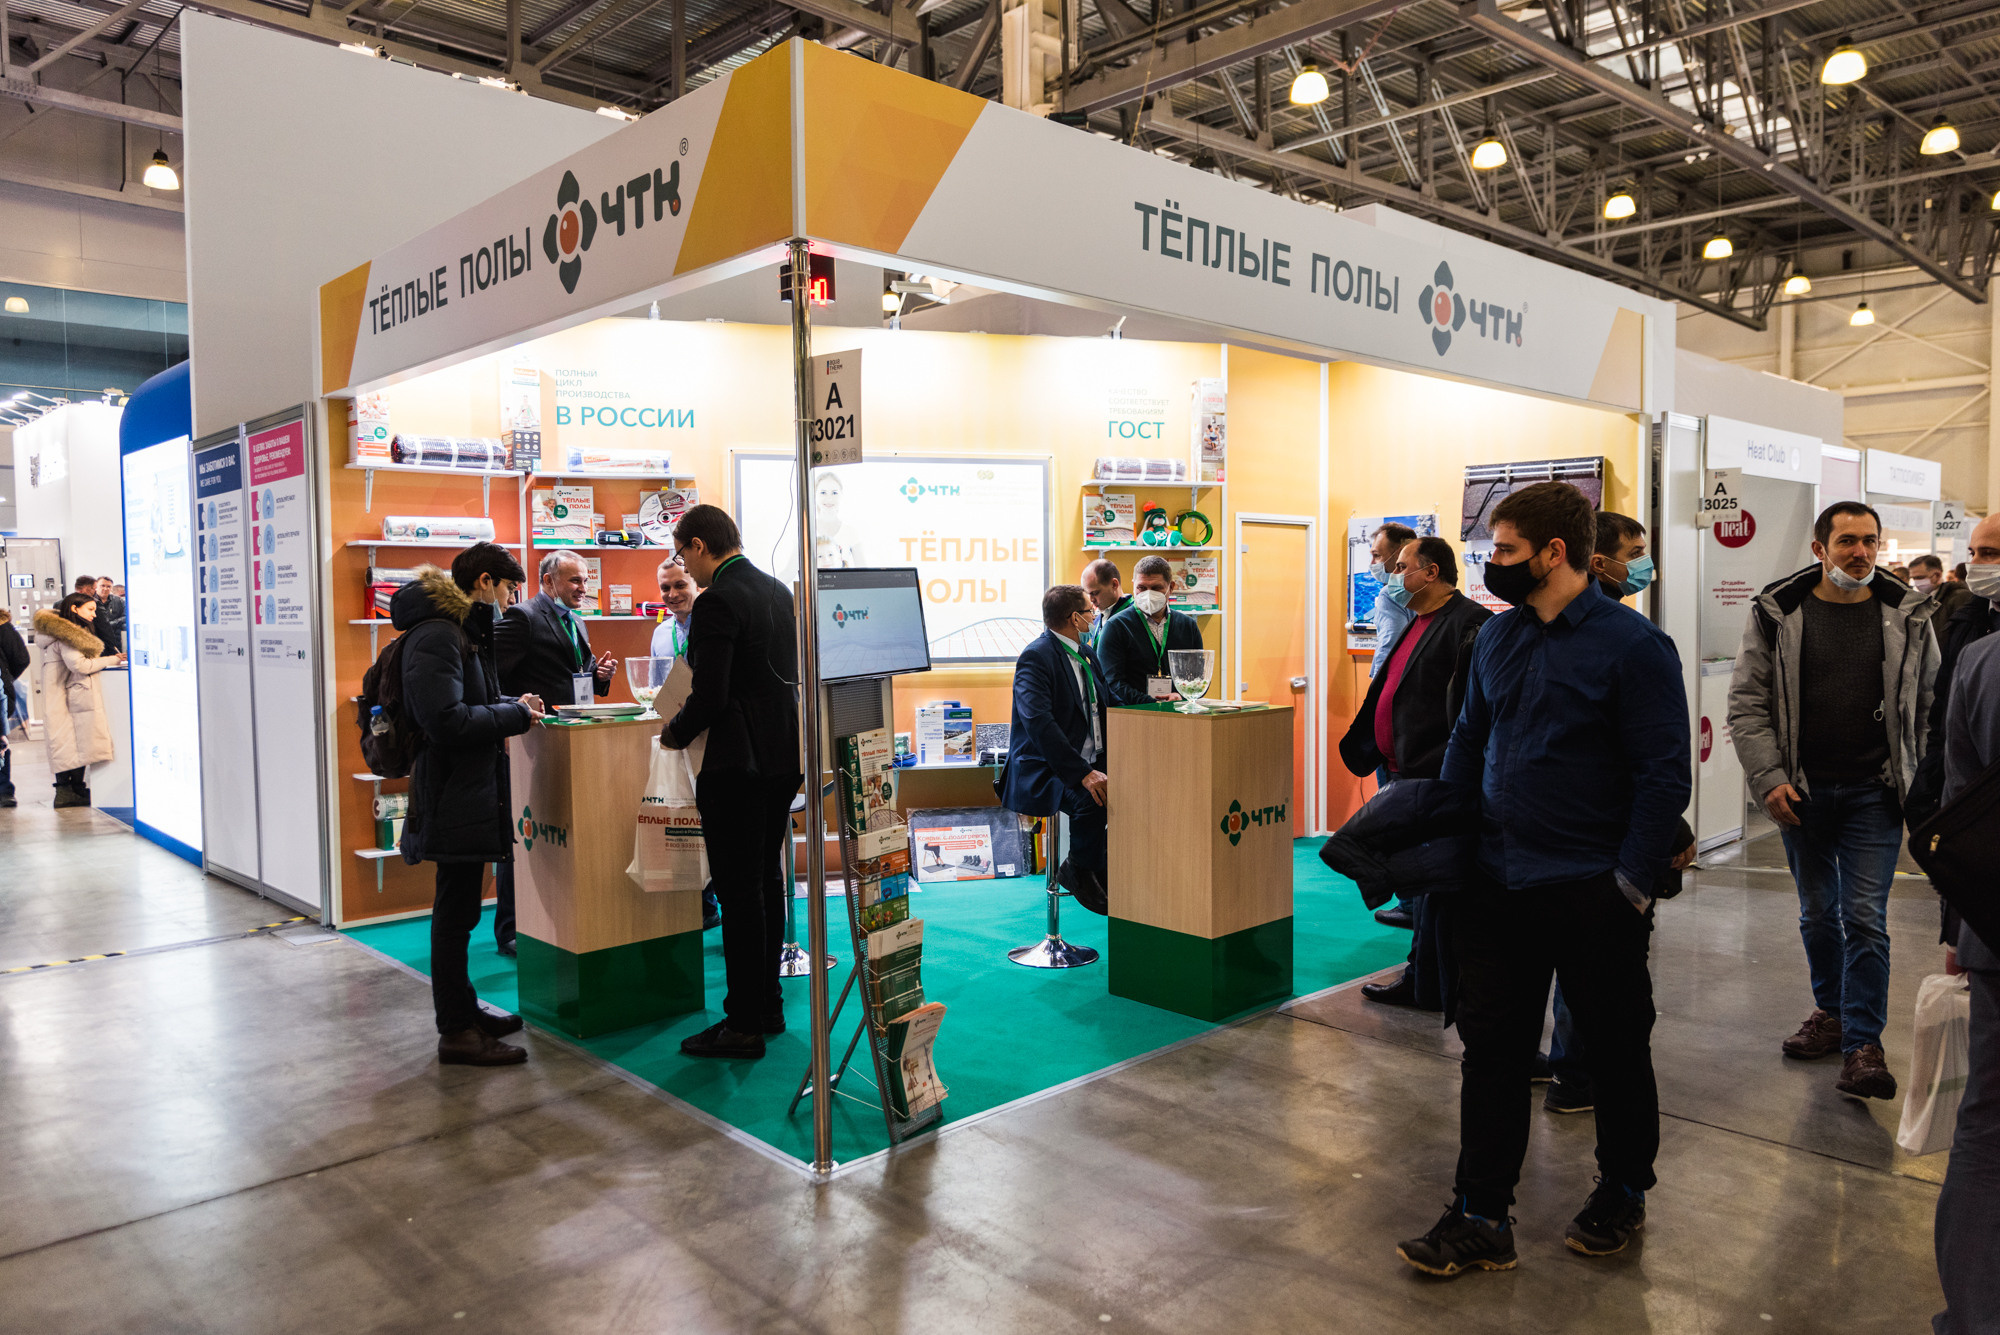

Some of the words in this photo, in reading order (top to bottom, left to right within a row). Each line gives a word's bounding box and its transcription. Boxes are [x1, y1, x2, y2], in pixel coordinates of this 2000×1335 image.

[1134, 198, 1291, 287] ТЁПЛЫЕ
[1311, 252, 1399, 314] ПОЛЫ
[369, 266, 448, 335] ТЁПЛЫЕ
[460, 227, 532, 298] ПОЛЫ
[555, 369, 598, 378] ПОЛНЫЙ
[555, 379, 583, 387] ЦИКЛ
[555, 389, 631, 399] ПРОИЗВОДСТВА
[556, 406, 572, 425] В
[581, 406, 694, 428] РОССИИ
[813, 414, 854, 442] 3021
[1108, 421, 1165, 439] ГОСТ
[1747, 440, 1766, 461] Heat
[1767, 444, 1785, 464] Club
[1704, 498, 1738, 511] 3025
[1936, 521, 1961, 530] 3027
[899, 530, 1039, 562] ТЁПЛЫЕ
[919, 578, 1007, 604] ОЛЫ
